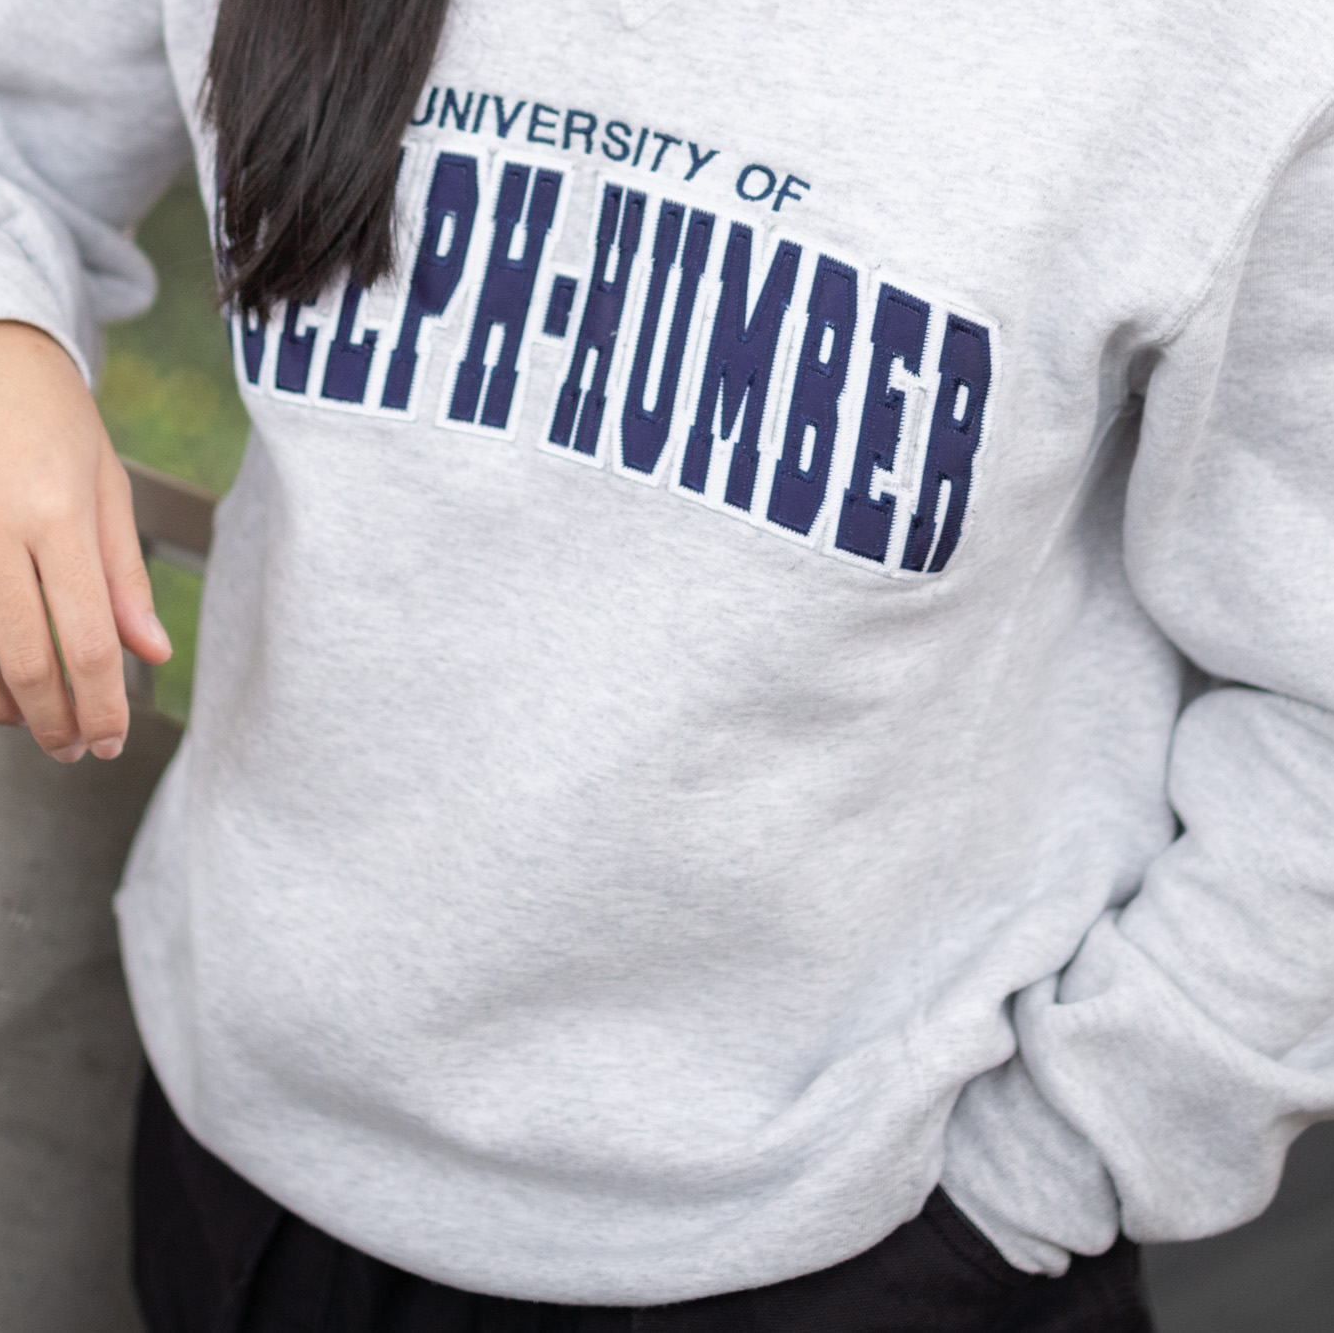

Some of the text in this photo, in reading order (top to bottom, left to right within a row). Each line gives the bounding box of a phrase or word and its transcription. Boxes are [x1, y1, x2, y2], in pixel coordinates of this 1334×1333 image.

[408, 87, 812, 212] UNIVERSITY OF
[218, 145, 992, 574] LPH-HUMBER
